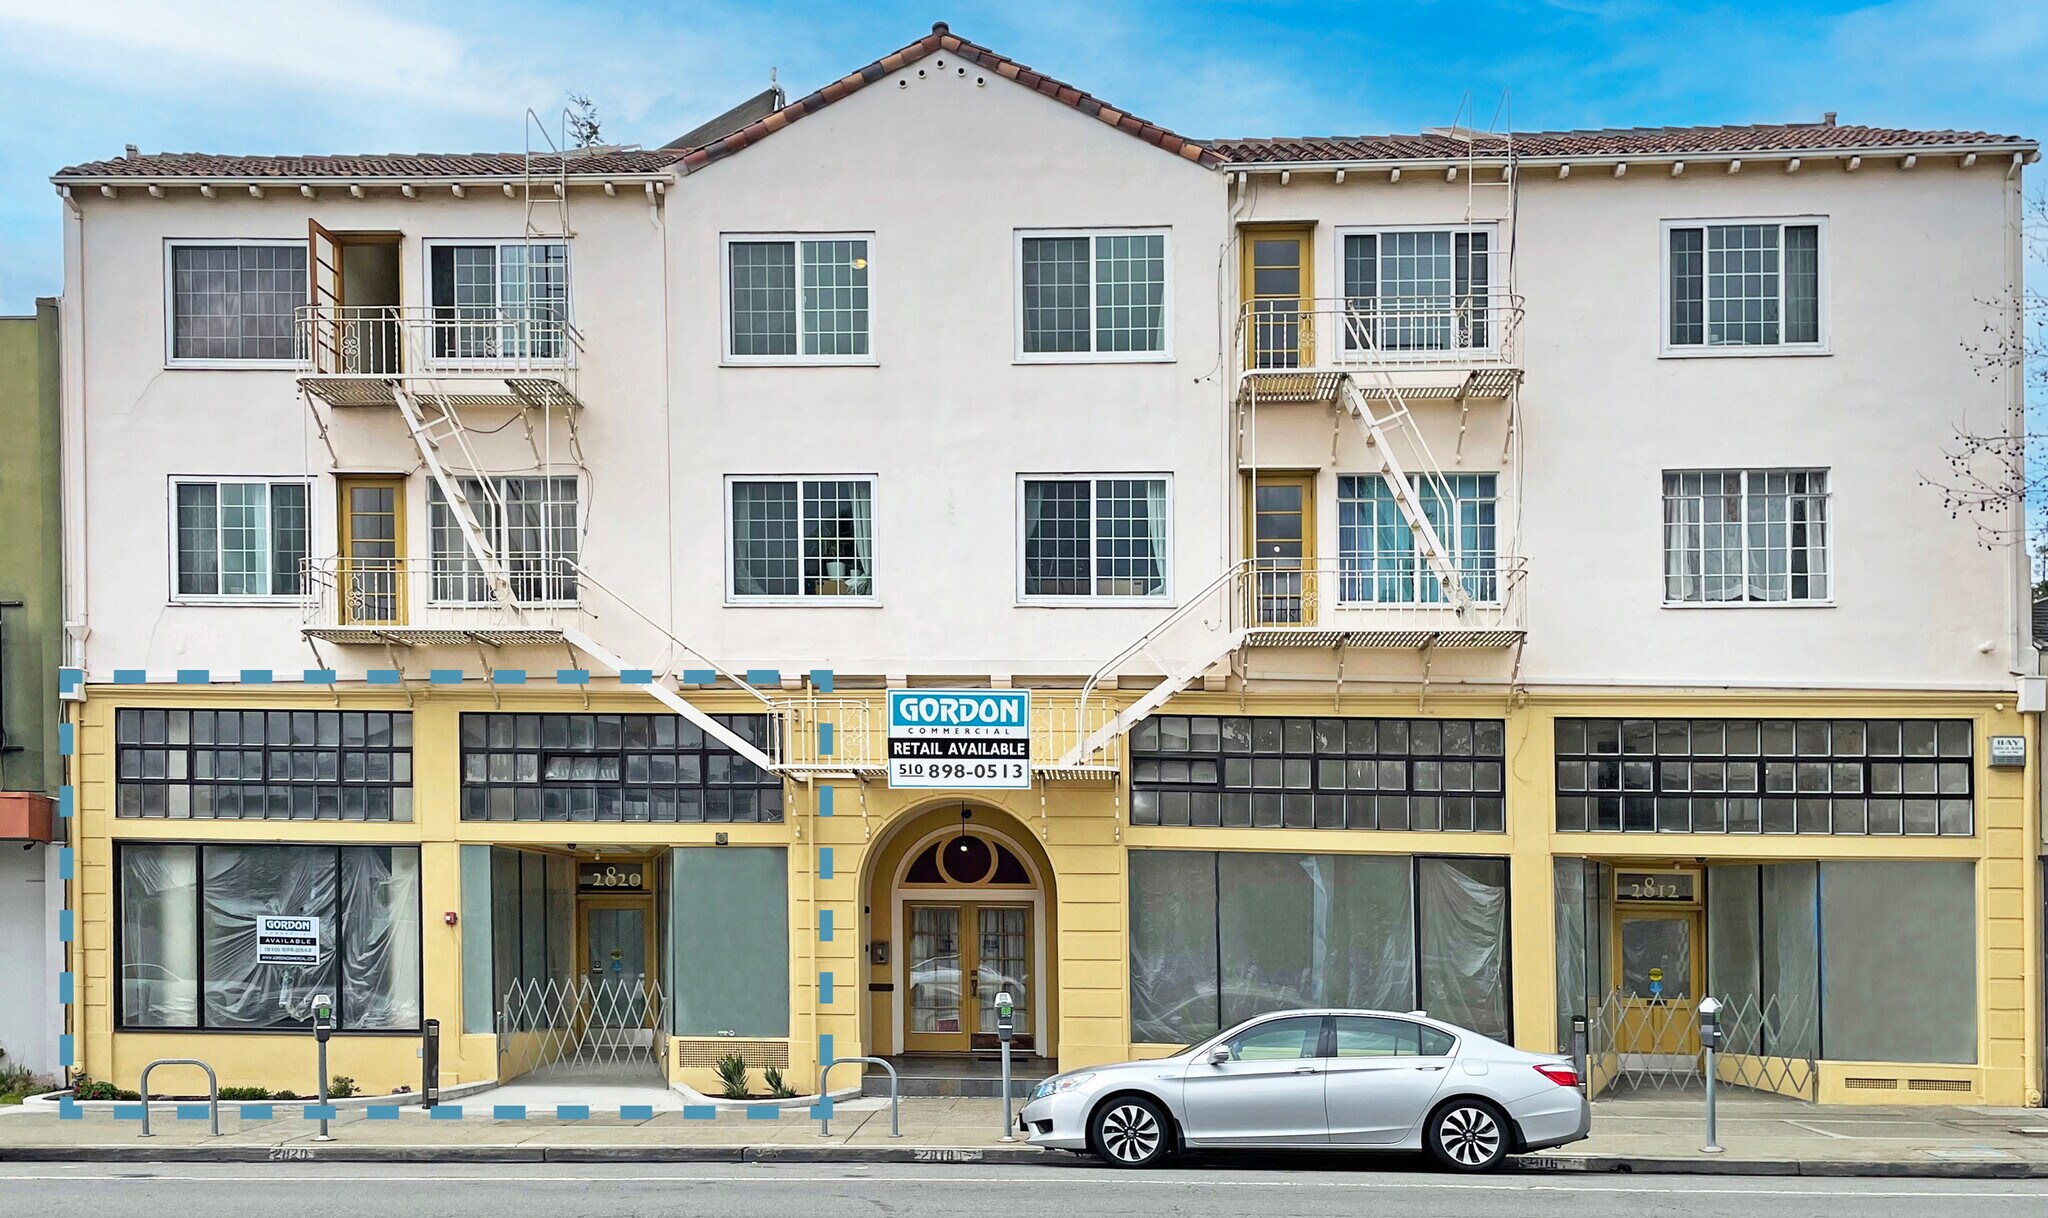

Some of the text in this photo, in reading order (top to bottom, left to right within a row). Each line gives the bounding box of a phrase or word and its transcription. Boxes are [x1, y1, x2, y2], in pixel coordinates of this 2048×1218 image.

[899, 697, 1019, 725] GORDON
[908, 727, 1010, 735] COMMERCIAL
[893, 742, 1026, 756] RETAIL AVAILABLE
[899, 764, 1023, 779] 510 898-0513
[592, 866, 642, 887] 2820
[1631, 877, 1680, 898] 2812
[266, 920, 310, 930] GORDON
